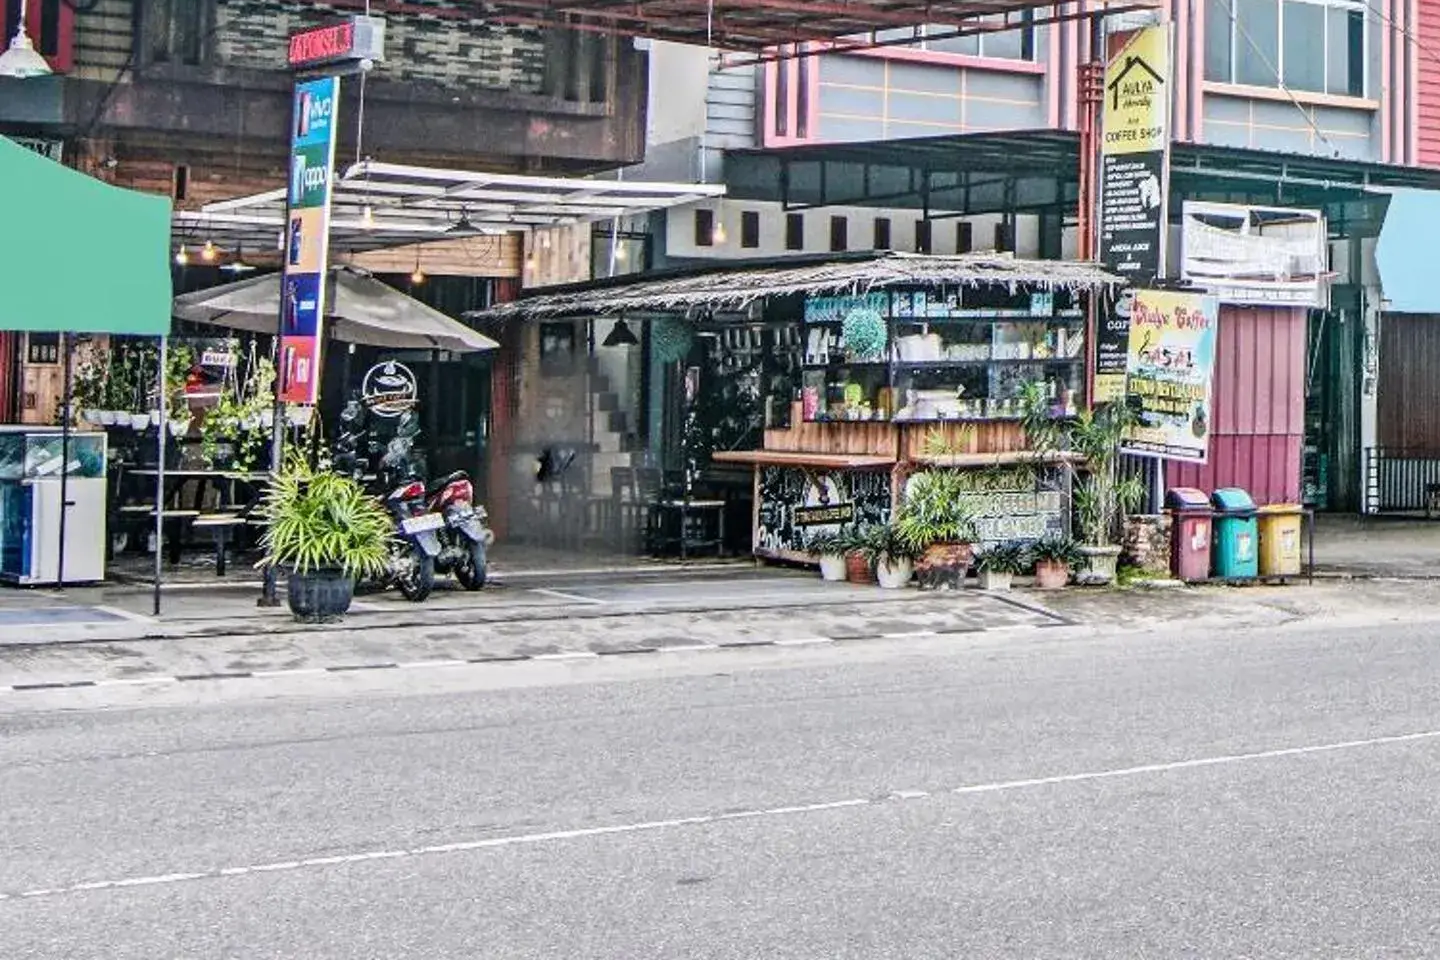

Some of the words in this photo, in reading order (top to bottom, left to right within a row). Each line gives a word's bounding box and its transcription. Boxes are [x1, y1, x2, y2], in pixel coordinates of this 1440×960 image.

[311, 96, 332, 120] vivo
[1105, 129, 1137, 143] COFFEE
[1140, 126, 1163, 140] SHOP
[305, 165, 327, 192] oppo
